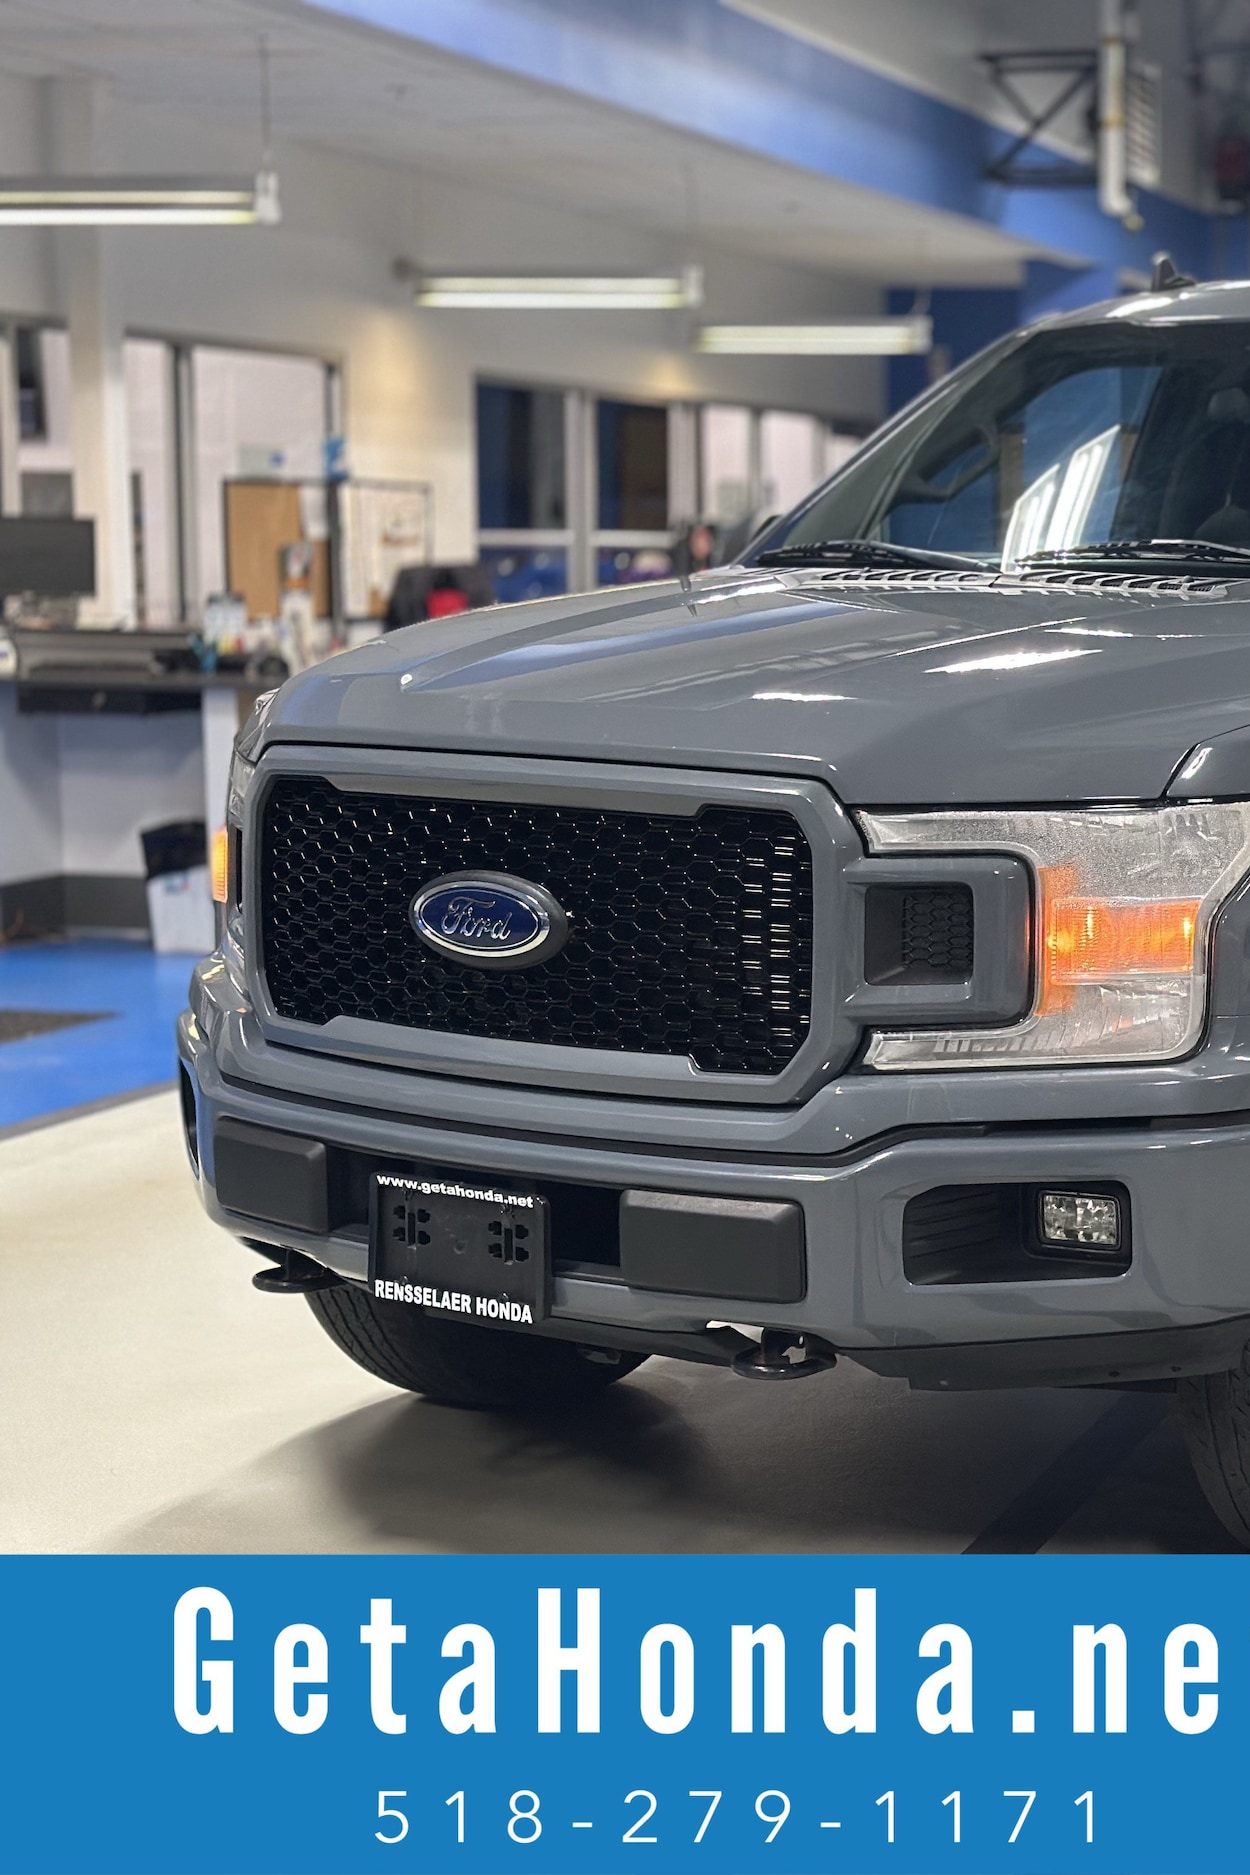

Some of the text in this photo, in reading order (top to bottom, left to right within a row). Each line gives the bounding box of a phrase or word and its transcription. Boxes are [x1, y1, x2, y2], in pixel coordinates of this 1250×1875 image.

[441, 896, 512, 941] Ford
[376, 1175, 534, 1209] www.getahonda.net
[375, 1279, 533, 1324] RENSSELAER HONDA
